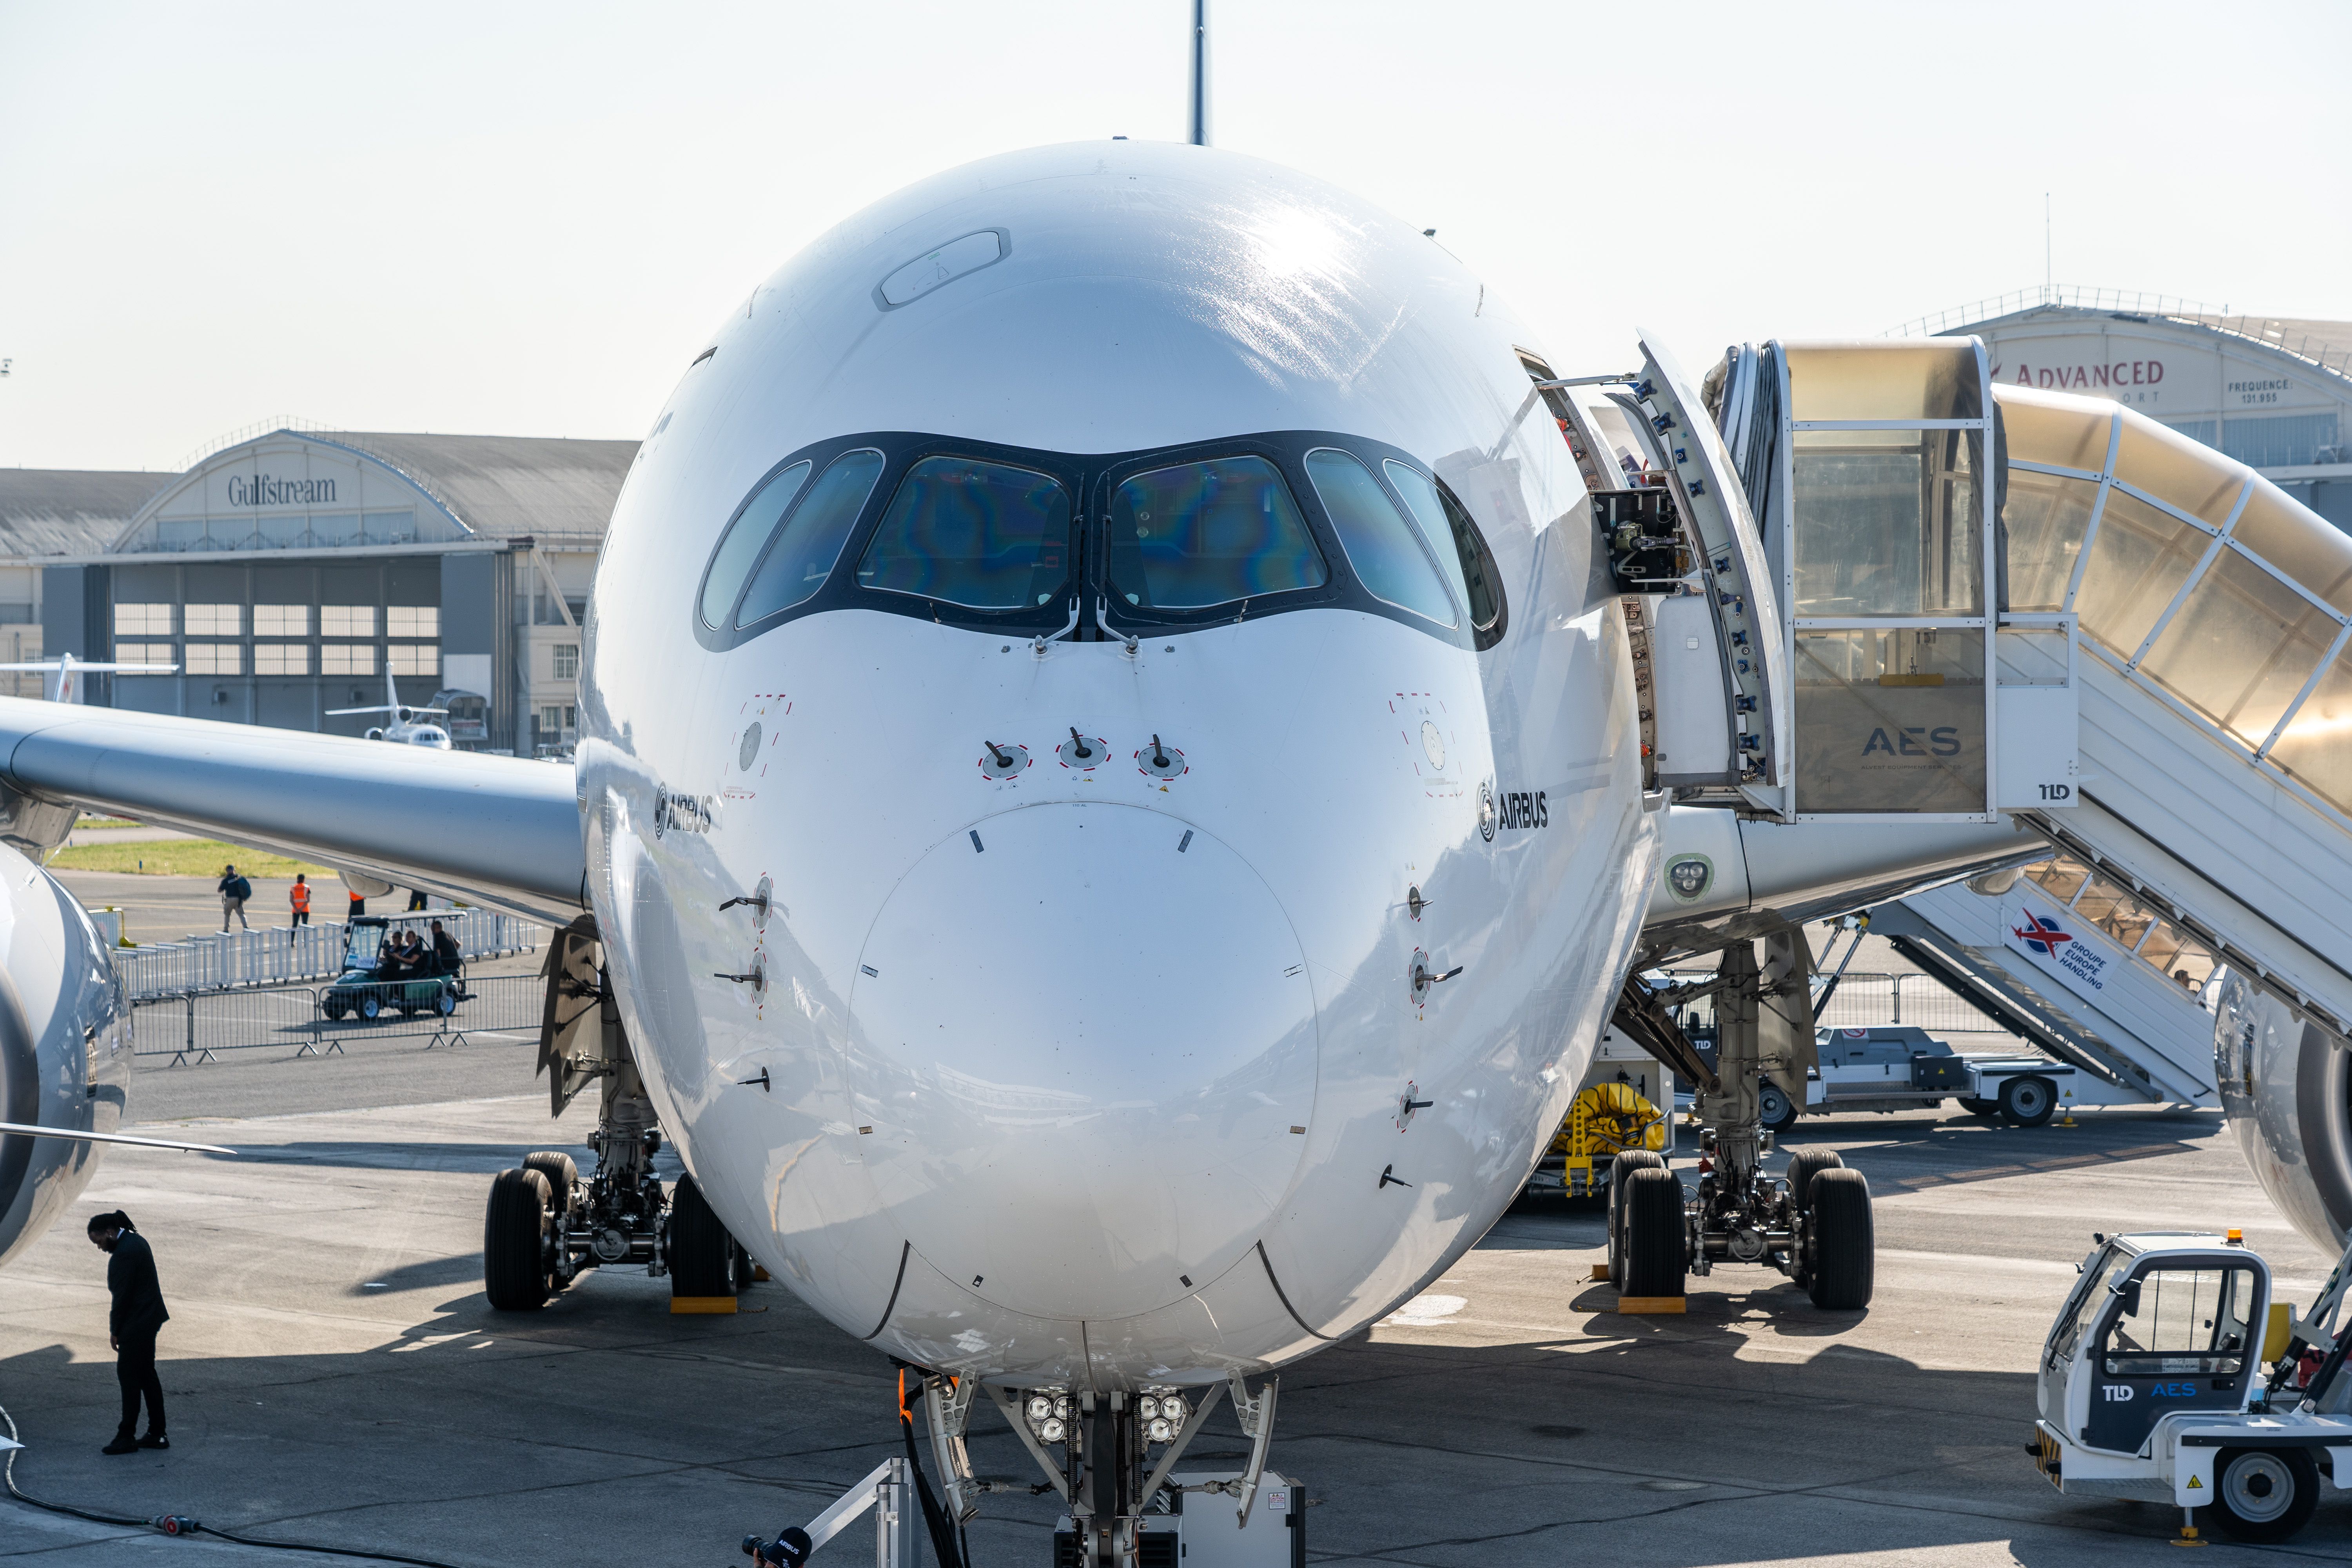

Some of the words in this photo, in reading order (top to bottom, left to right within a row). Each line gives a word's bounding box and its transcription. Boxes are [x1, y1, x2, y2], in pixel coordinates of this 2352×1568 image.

[2017, 360, 2164, 389] ADVANCED
[2243, 392, 2277, 403] 131.955
[229, 473, 336, 506] Gulfstream
[1861, 727, 1961, 756] AES
[2039, 784, 2070, 800] TLD
[666, 794, 713, 833] AIRBUS
[1499, 791, 1548, 830] AIRBUS
[2065, 949, 2100, 976] EUROPE
[2072, 942, 2107, 968] GROUPE
[2059, 957, 2103, 989] HANDLING
[1695, 1040, 1711, 1049] TLD
[2102, 1385, 2134, 1401] TLD
[2151, 1383, 2196, 1397] AES
[779, 1539, 799, 1554] AIRBUS
